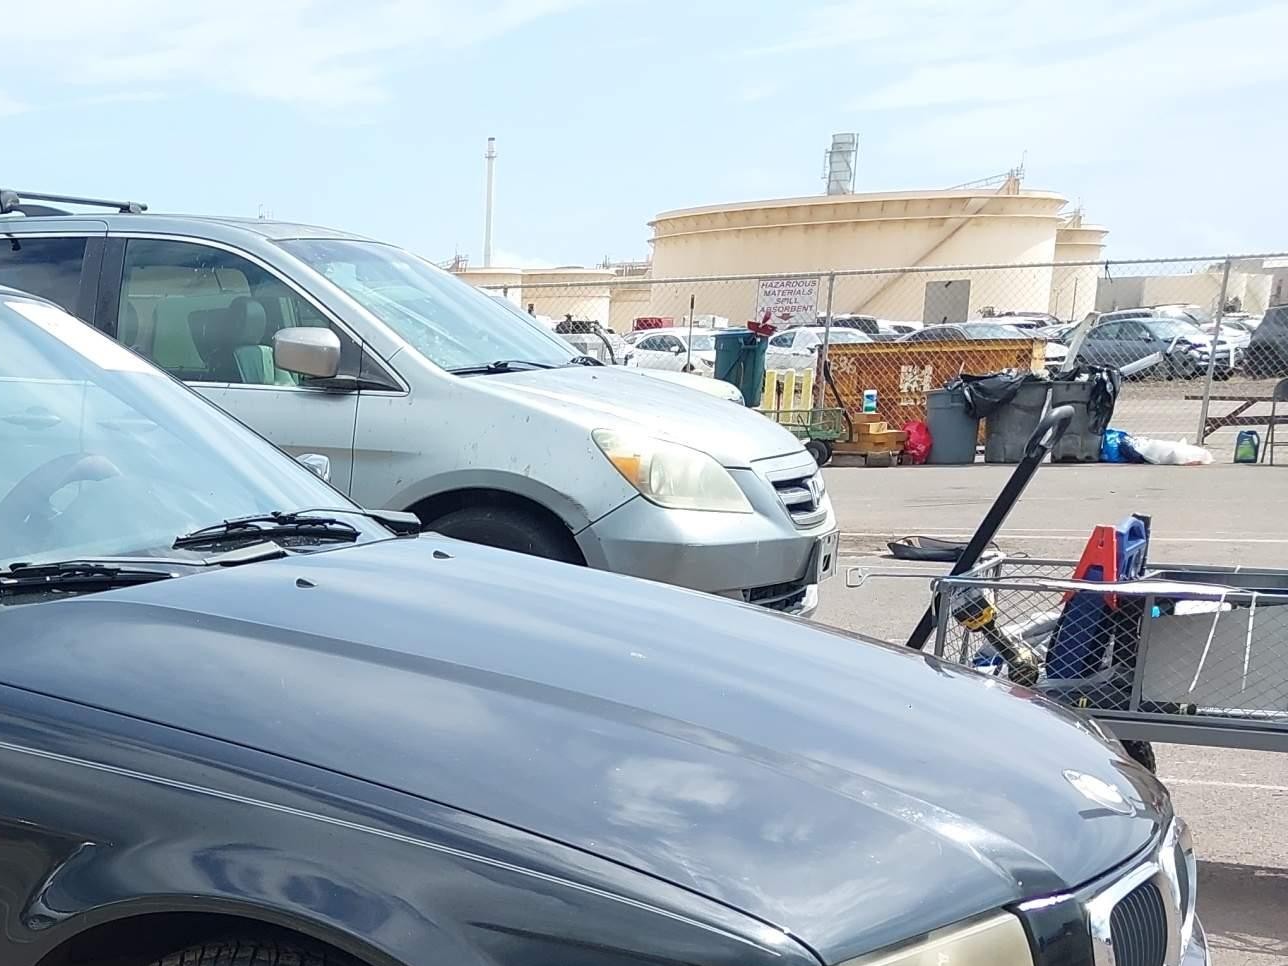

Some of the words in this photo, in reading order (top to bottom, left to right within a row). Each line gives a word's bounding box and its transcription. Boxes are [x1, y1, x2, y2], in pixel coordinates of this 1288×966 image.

[761, 280, 817, 289] HAZARDOUS
[763, 288, 814, 297] MATERIALS
[775, 297, 800, 305] SPILL
[759, 305, 814, 313] ABSORBENT
